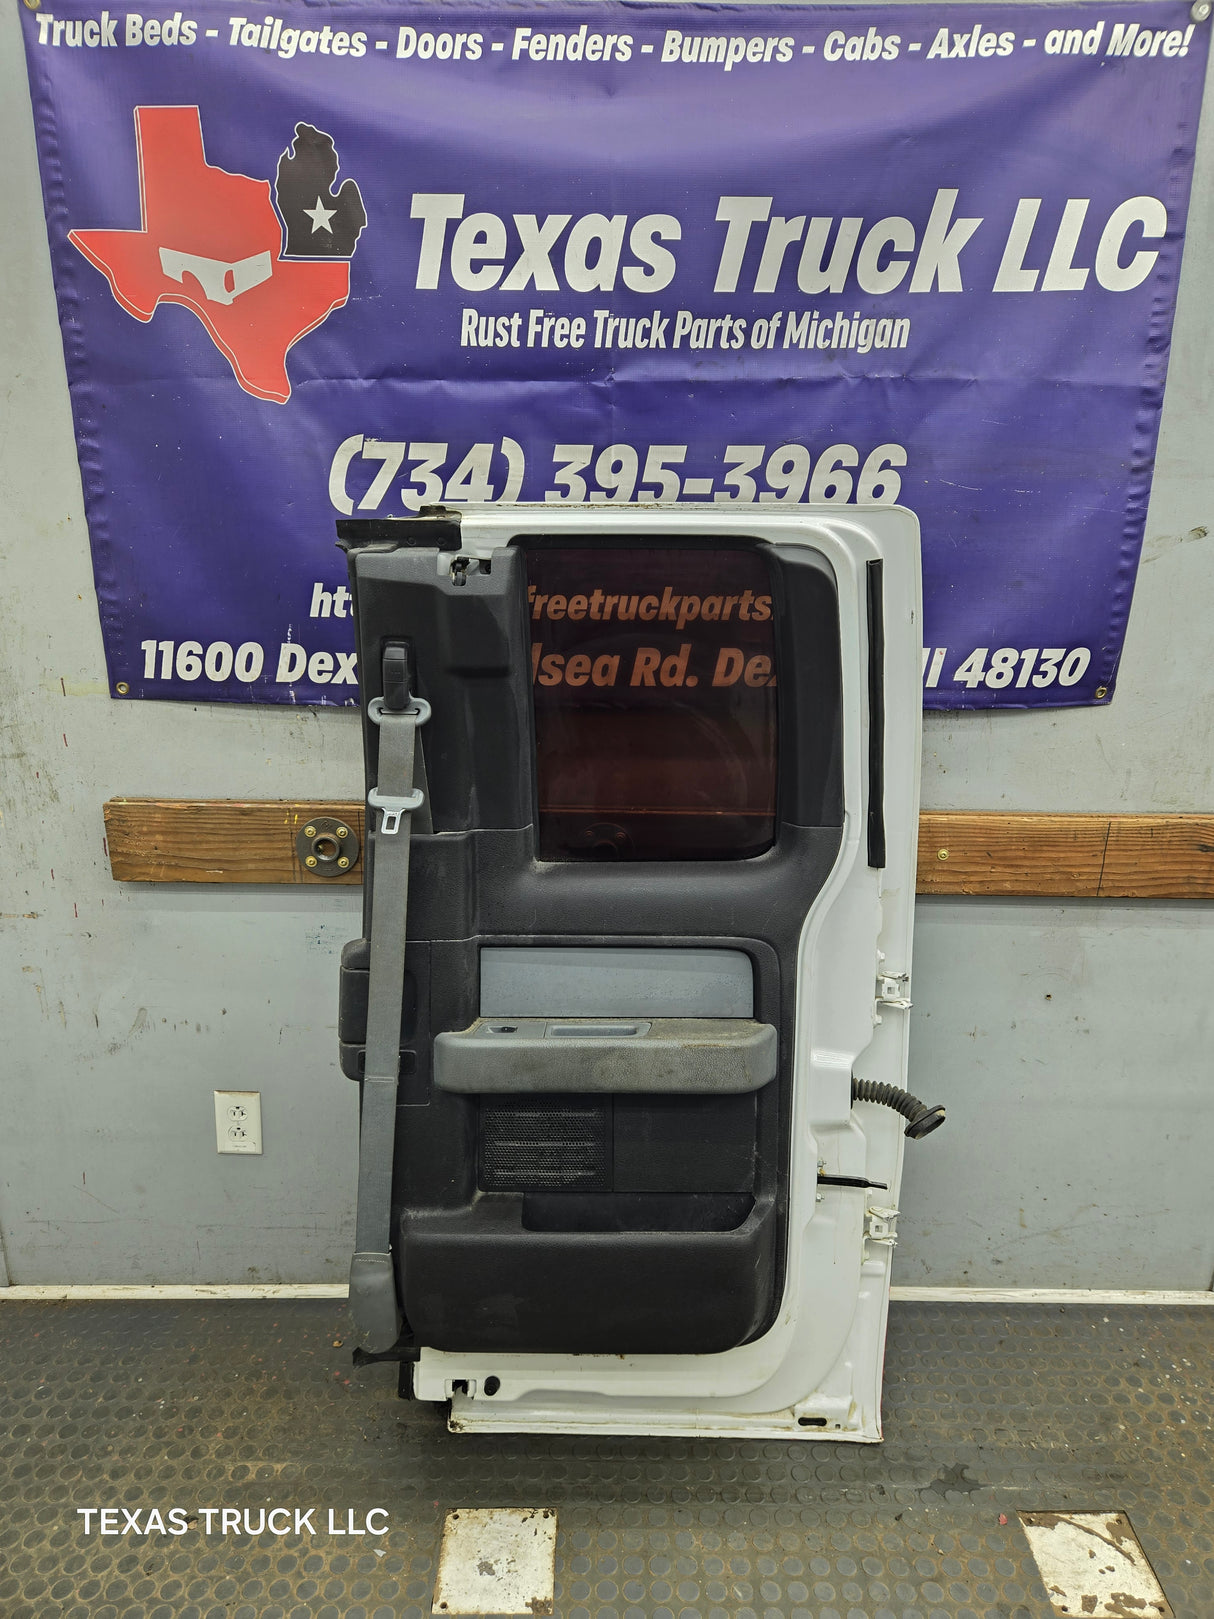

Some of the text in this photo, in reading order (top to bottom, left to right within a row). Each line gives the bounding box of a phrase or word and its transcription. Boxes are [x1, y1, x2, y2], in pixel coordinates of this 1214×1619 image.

[36, 11, 118, 47] Truck
[126, 12, 197, 46] Beds
[229, 16, 367, 58] Tailgates
[396, 27, 483, 60] Doors
[511, 25, 633, 61] Fenders
[661, 29, 795, 71] Bumpers
[823, 27, 901, 61] Cabs
[926, 24, 1015, 60] Axles
[1044, 21, 1105, 55] and
[1106, 24, 1195, 57] More!
[410, 188, 1168, 295] Texas Truck LLC
[460, 308, 910, 354] Rust Free Truck Parts of Michigan
[328, 433, 908, 516] (734) 395-3966
[527, 585, 773, 630] reetruckparts
[141, 639, 264, 682] 11600
[275, 642, 358, 685] Dex
[629, 643, 698, 687] Rd.
[712, 647, 777, 687] De
[922, 647, 947, 688] I
[953, 647, 1091, 689] 48130
